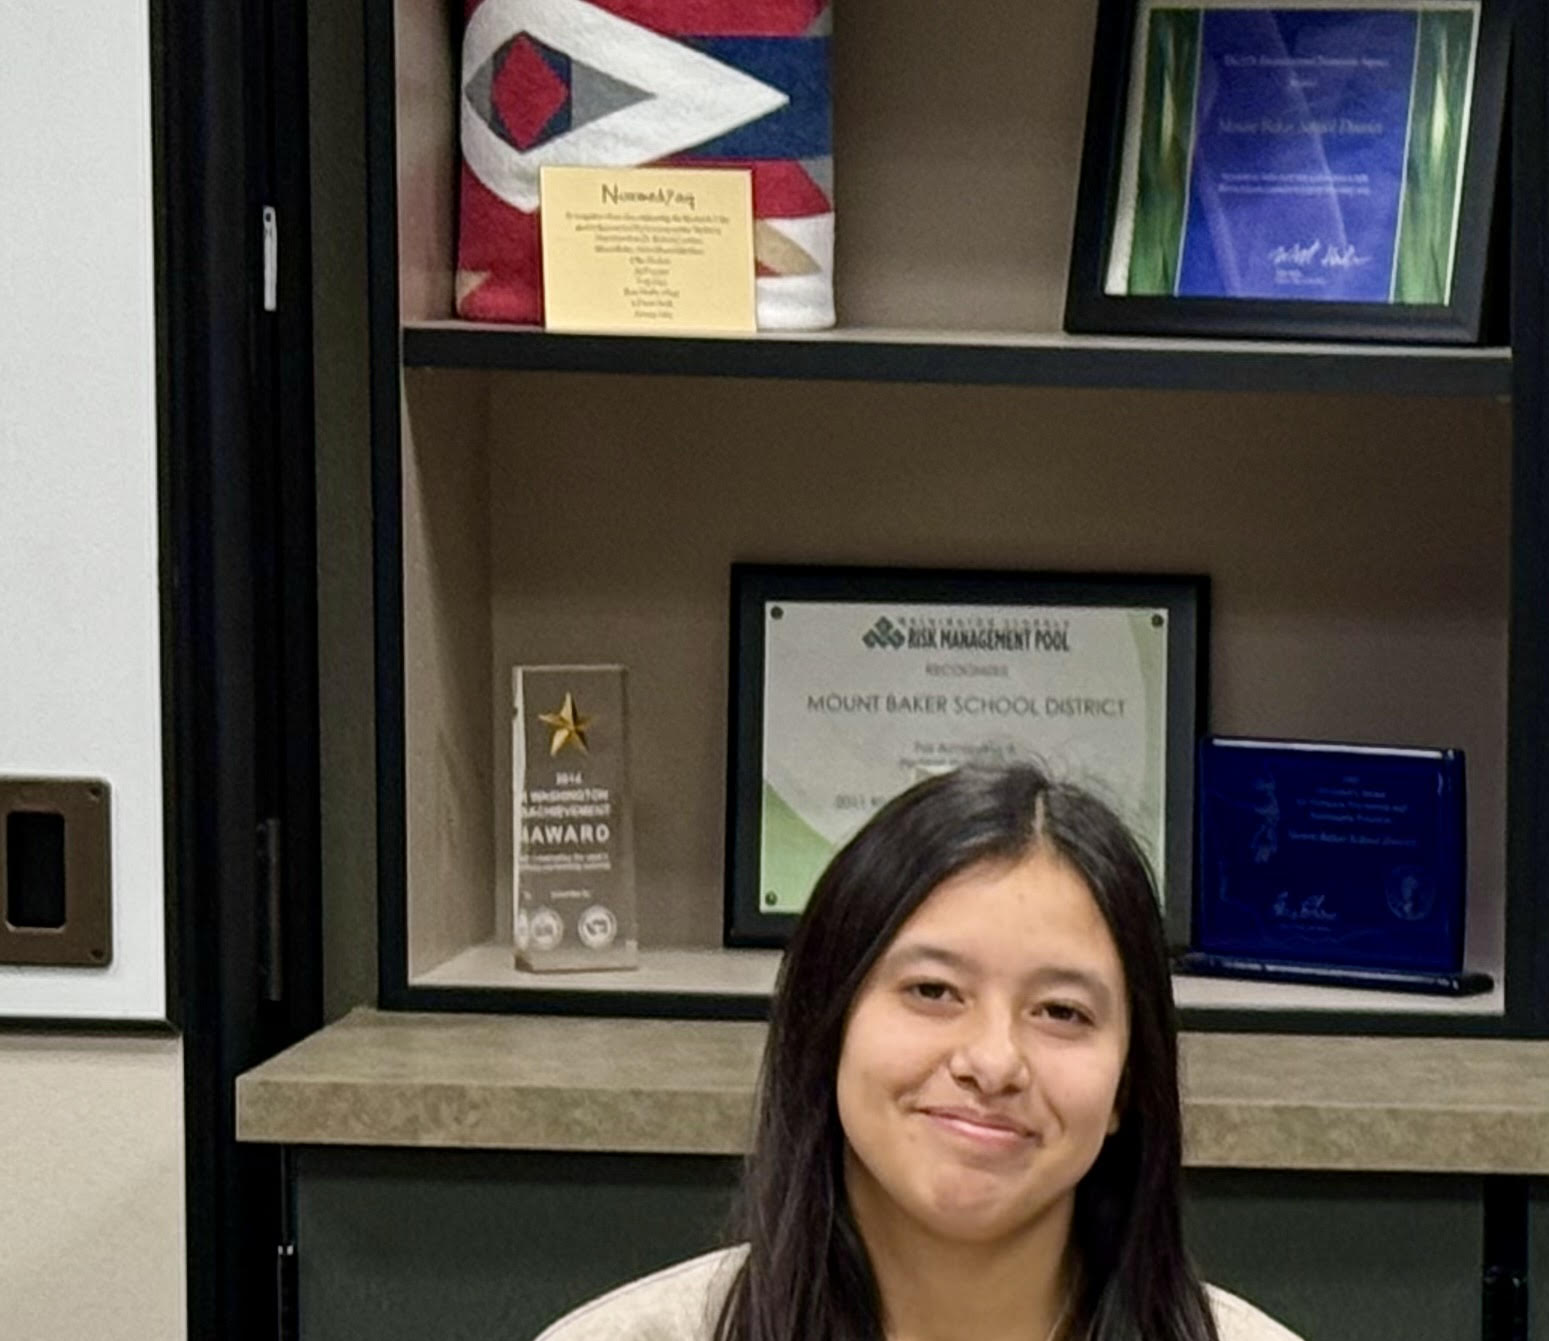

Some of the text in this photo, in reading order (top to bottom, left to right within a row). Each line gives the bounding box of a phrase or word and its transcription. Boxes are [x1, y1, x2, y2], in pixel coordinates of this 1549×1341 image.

[907, 628, 1070, 652] RISK MANAGEMENT POOL
[807, 695, 1126, 718] MOUNT BAKER SCHOOL DISTRICT
[530, 824, 610, 844] AWARD
